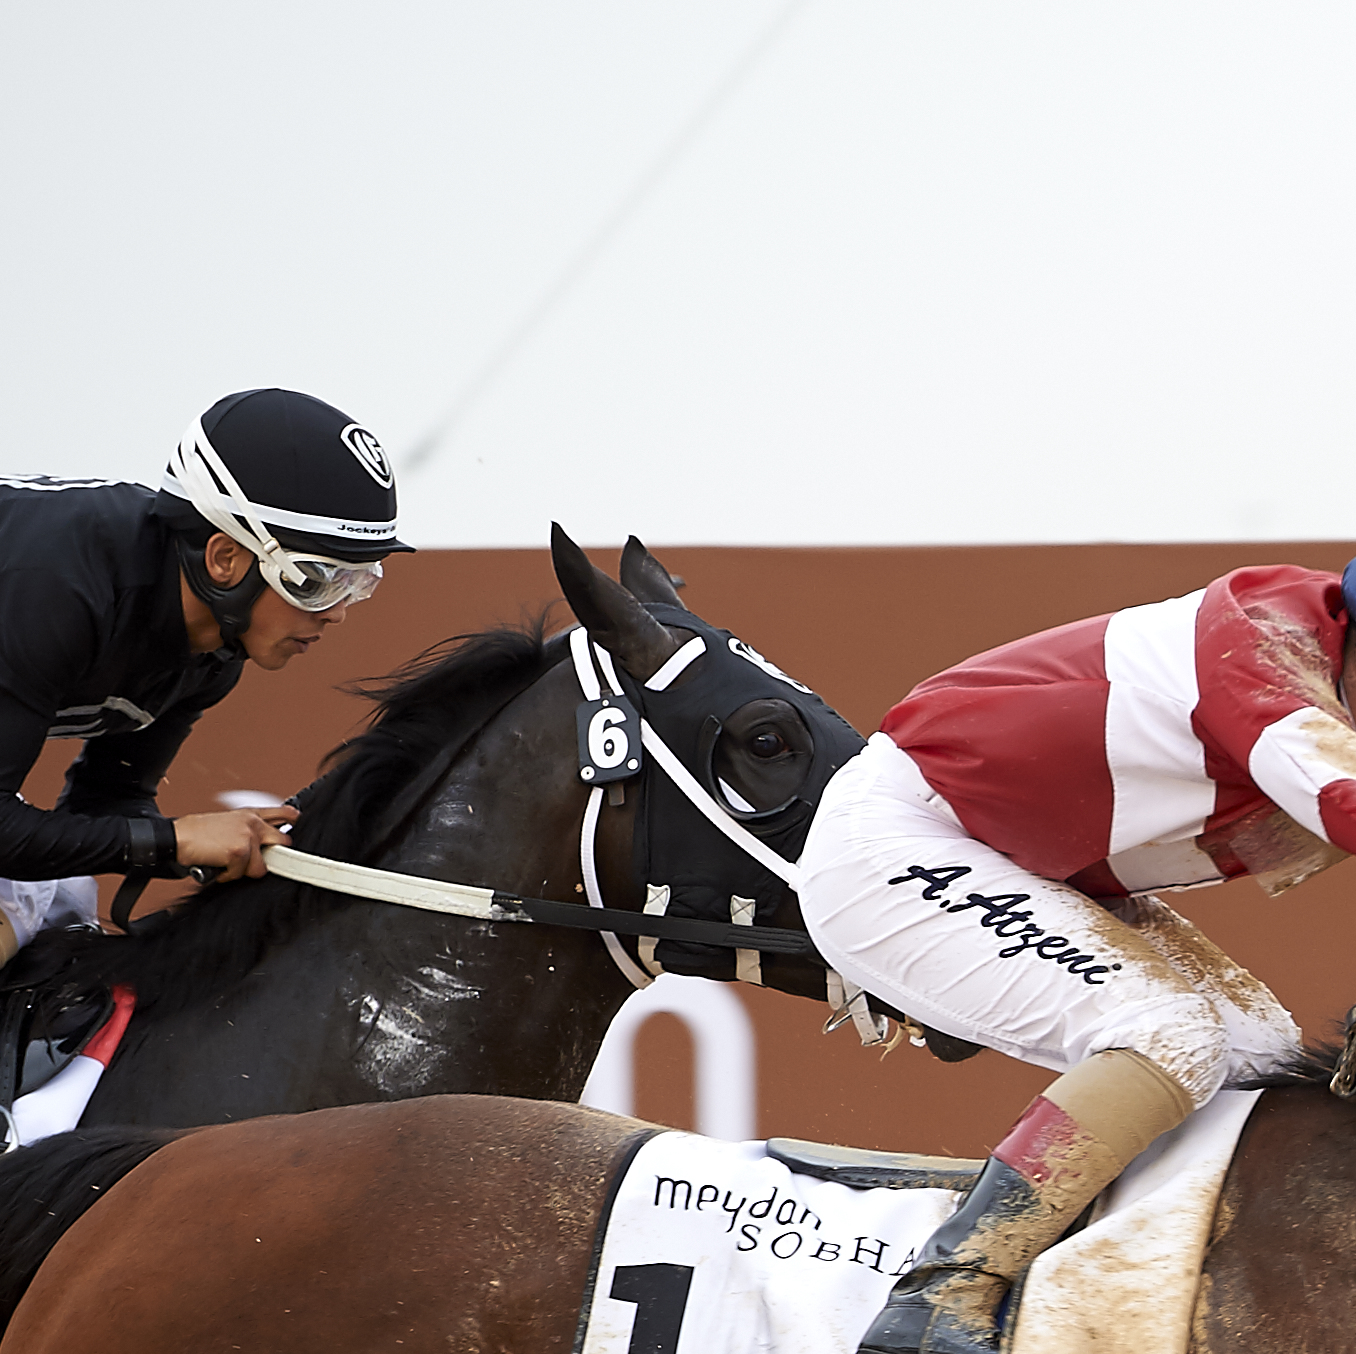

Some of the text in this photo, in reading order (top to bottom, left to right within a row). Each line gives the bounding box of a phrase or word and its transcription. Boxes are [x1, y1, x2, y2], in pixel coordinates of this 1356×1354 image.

[588, 707, 629, 769] 6
[947, 893, 1122, 985] Atzeni
[654, 1174, 822, 1234] meydan
